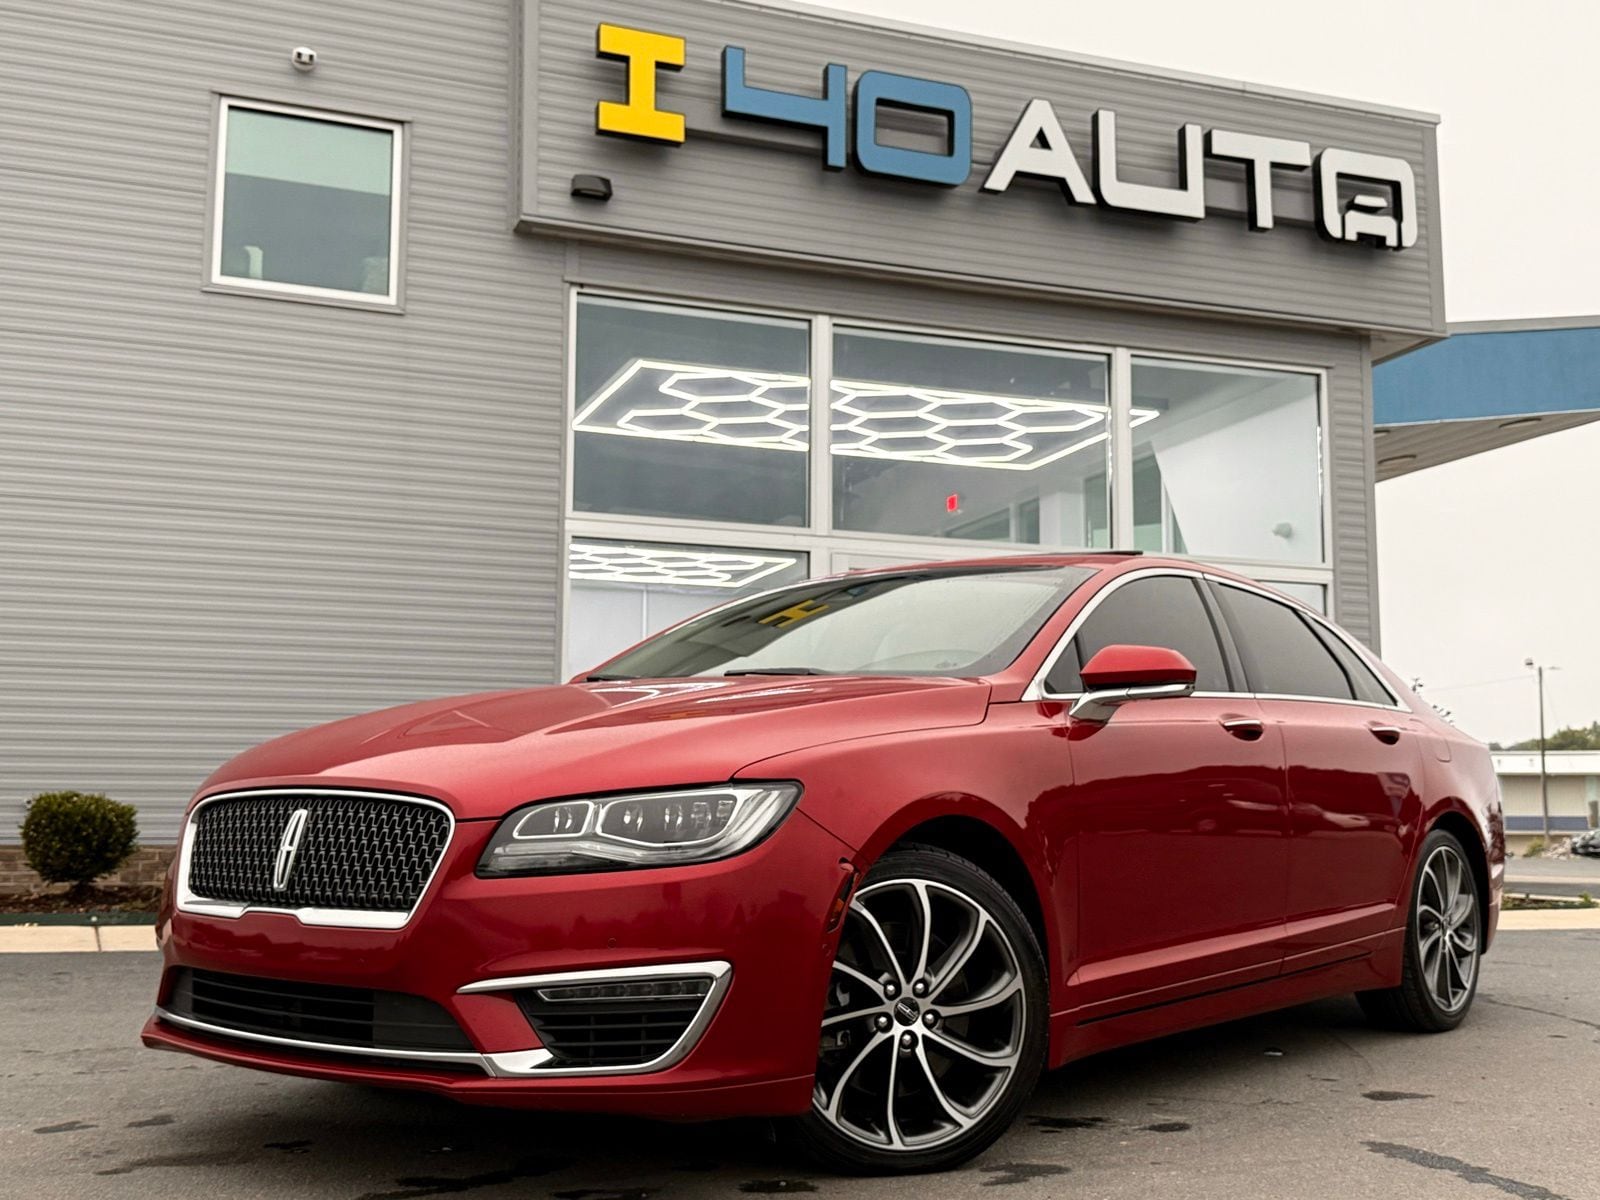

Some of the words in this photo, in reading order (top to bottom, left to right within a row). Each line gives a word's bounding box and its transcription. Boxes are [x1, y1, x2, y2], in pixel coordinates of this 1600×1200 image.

[597, 23, 686, 144] I
[722, 45, 972, 187] 40
[982, 98, 1419, 249] AUTO
